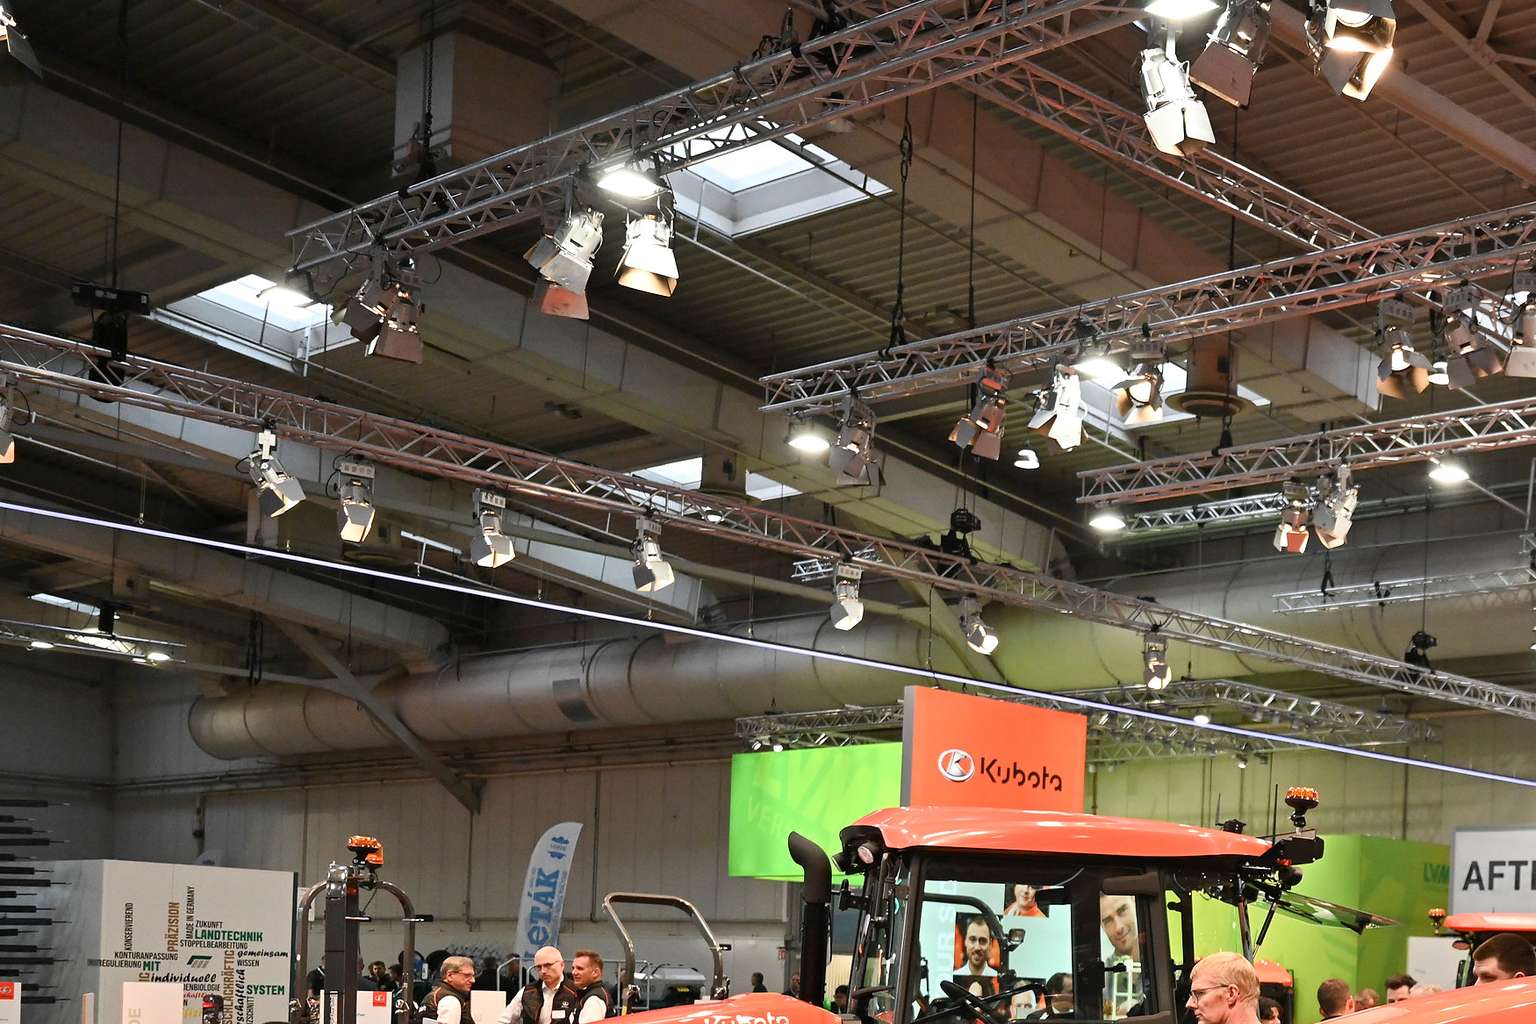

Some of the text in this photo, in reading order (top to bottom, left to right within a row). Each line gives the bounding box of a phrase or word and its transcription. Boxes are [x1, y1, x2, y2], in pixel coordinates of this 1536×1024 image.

[980, 757, 1062, 791] Kubota
[123, 902, 134, 951] KONSERVIEREND
[164, 902, 180, 952] PRÄZISION
[195, 920, 223, 929] ZUKUNFT
[194, 929, 264, 942] LANDTECHNIK
[180, 939, 248, 950] STOPPELBEARBEITUNG
[114, 951, 179, 961] KONTURANPASSUNG
[237, 948, 288, 958] gemeinsam
[142, 961, 161, 971] MIT
[237, 959, 260, 967] WISSEN
[151, 972, 217, 983] individuell
[183, 983, 220, 992] ENBIOLOGIE
[246, 984, 285, 995] SYSTEM
